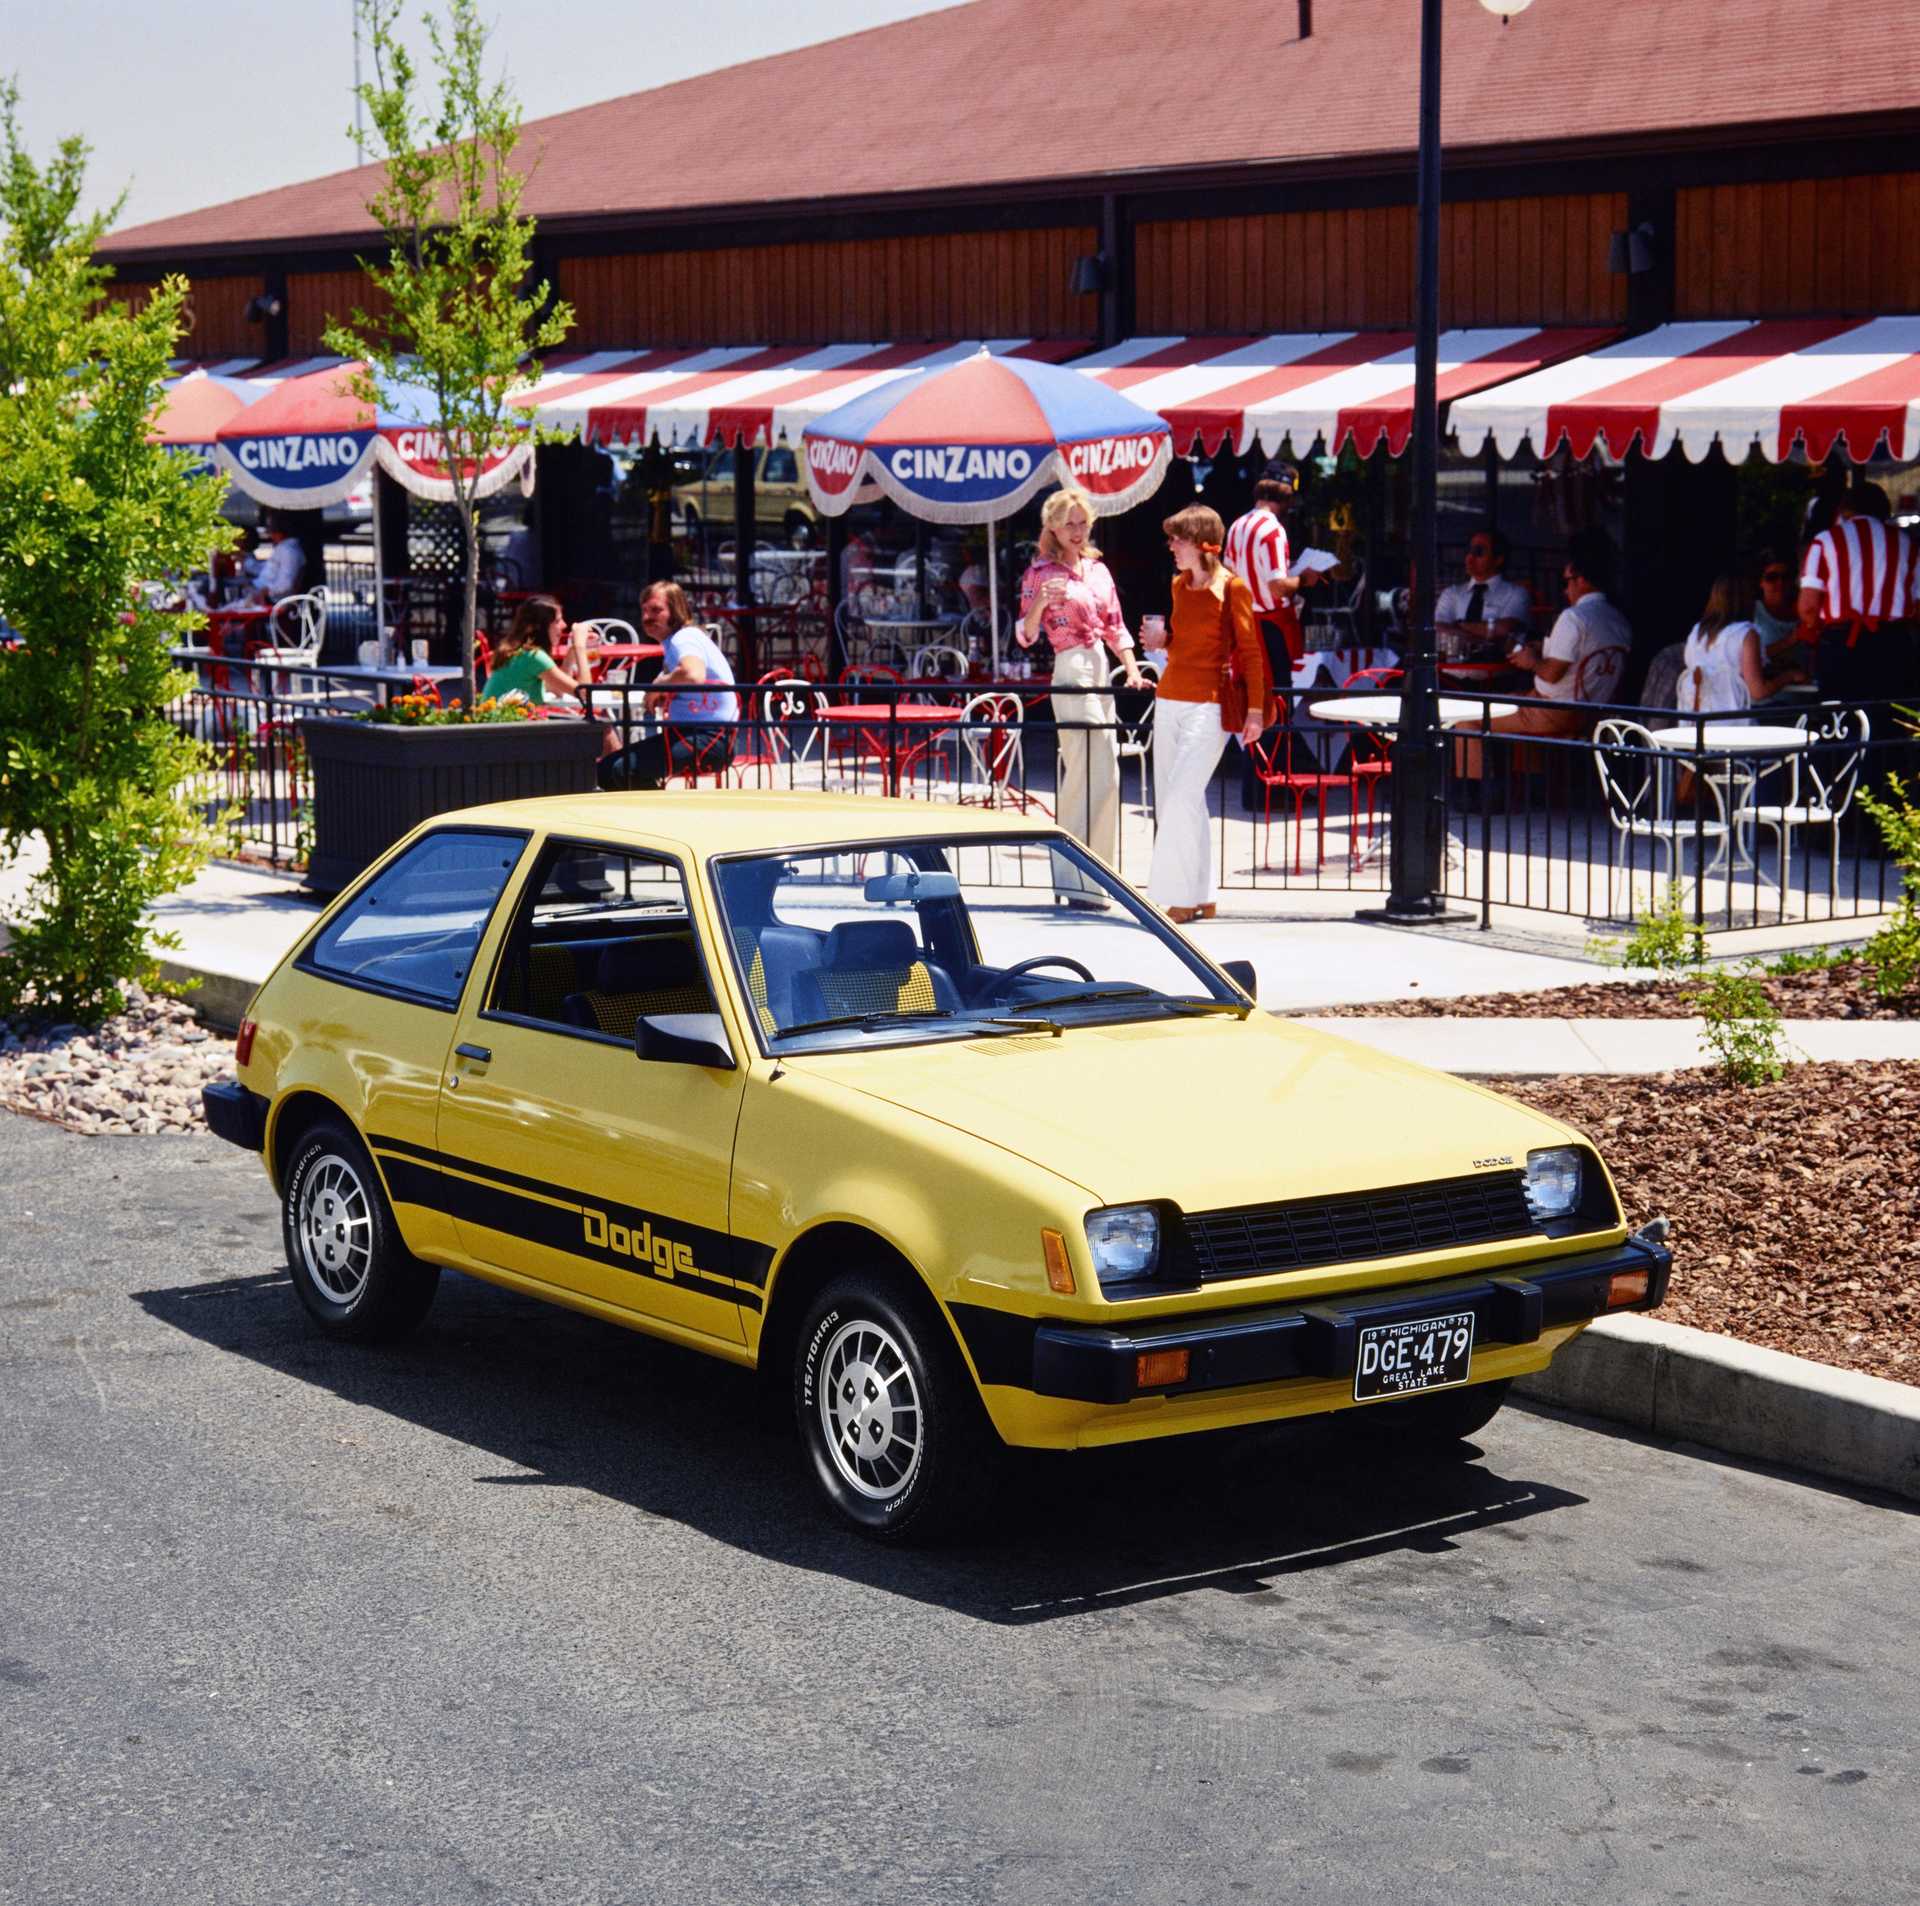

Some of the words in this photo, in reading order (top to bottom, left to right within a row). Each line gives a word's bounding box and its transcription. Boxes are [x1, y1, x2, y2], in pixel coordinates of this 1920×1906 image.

[239, 435, 359, 471] CINZANO
[810, 439, 857, 475] CINZANO
[890, 446, 1031, 482] CINZANO
[1069, 436, 1154, 476] CINZANO
[582, 1206, 700, 1279] Dodge
[1367, 1331, 1377, 1340] 19
[1389, 1319, 1447, 1337] MICHIGAN
[1457, 1317, 1468, 1326] 79
[1382, 1370, 1414, 1384] GREAT
[1420, 1365, 1445, 1377] LAKE
[1398, 1377, 1428, 1391] STATE
